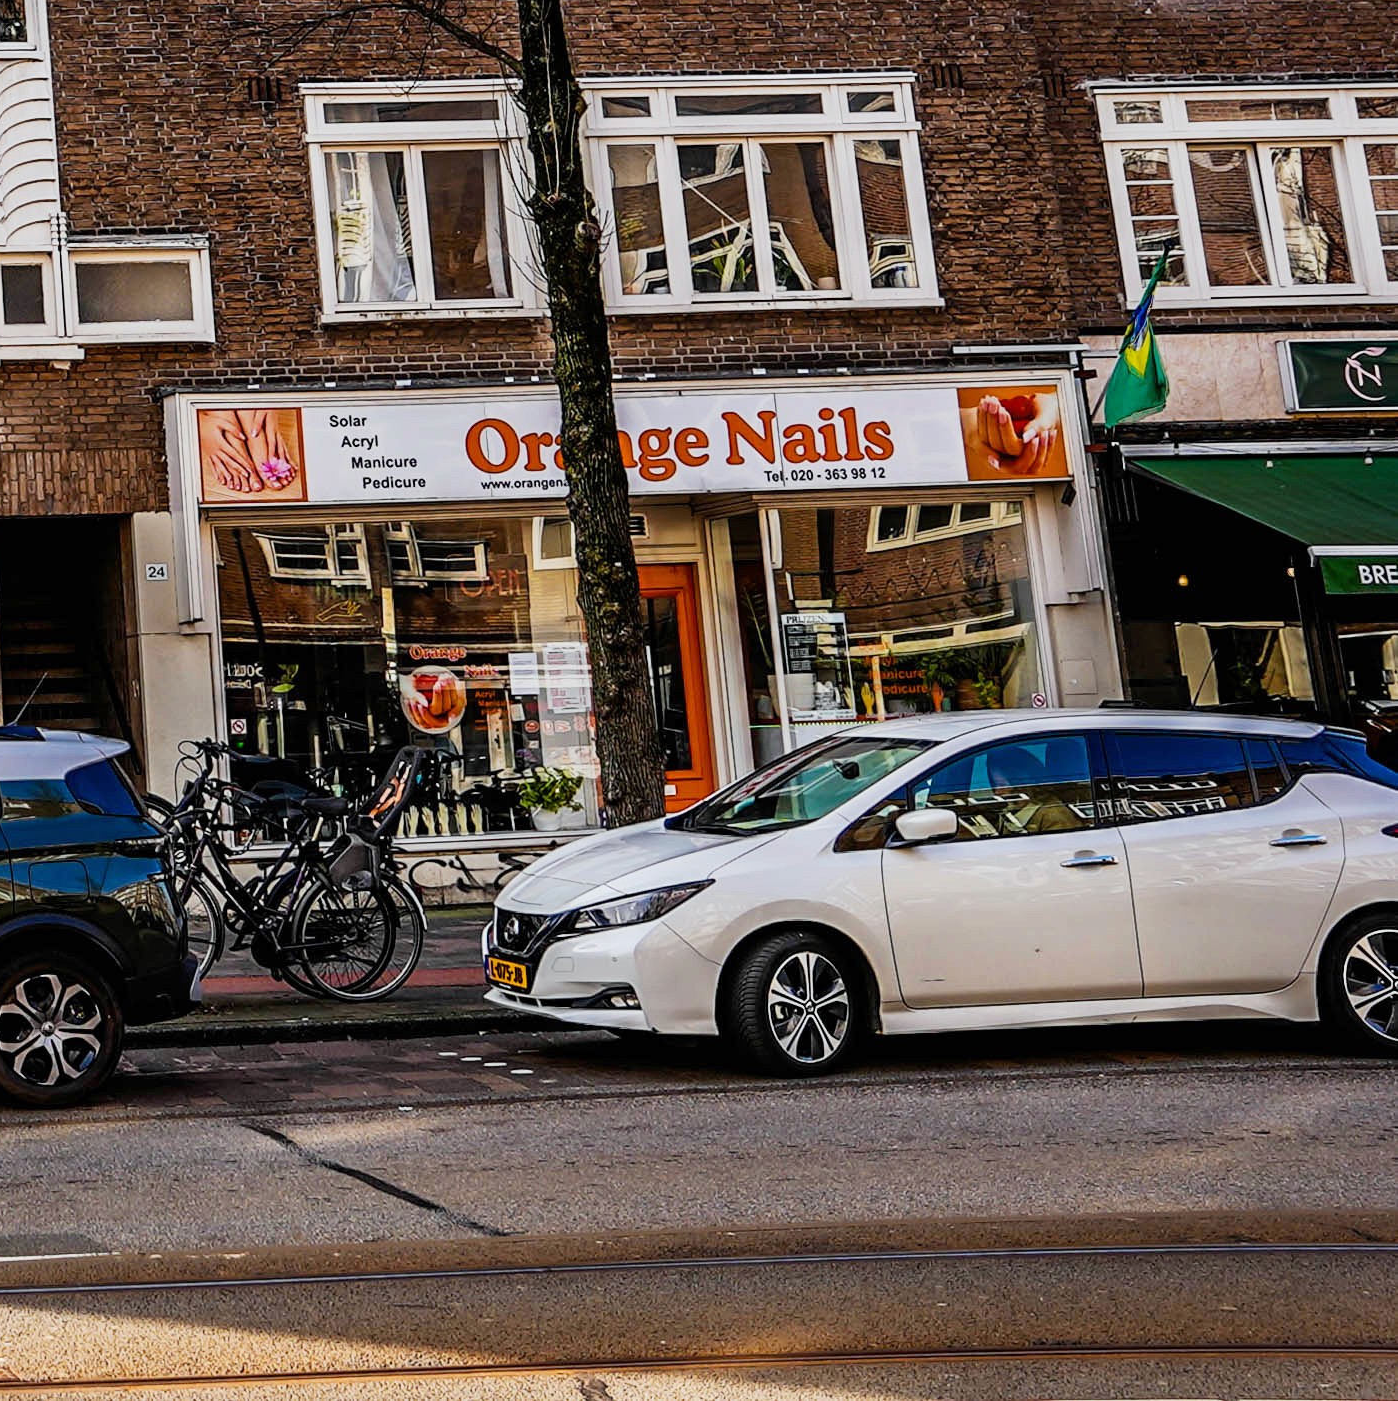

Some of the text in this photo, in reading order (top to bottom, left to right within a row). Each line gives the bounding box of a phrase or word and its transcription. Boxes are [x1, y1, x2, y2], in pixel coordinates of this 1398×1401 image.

[329, 414, 367, 428] Solar
[341, 435, 379, 450] Acryl
[465, 407, 895, 482] Orge Nails
[351, 456, 418, 469] Manicure
[764, 470, 789, 482] Tel.
[791, 470, 813, 481] 020
[825, 469, 848, 480] 363
[850, 468, 867, 479] 98
[871, 467, 886, 478] 12
[362, 475, 427, 490] Pedicure
[481, 479, 569, 491] www.orangena
[148, 566, 165, 578] 24
[1359, 565, 1398, 584] BRE
[409, 645, 467, 662] Orange
